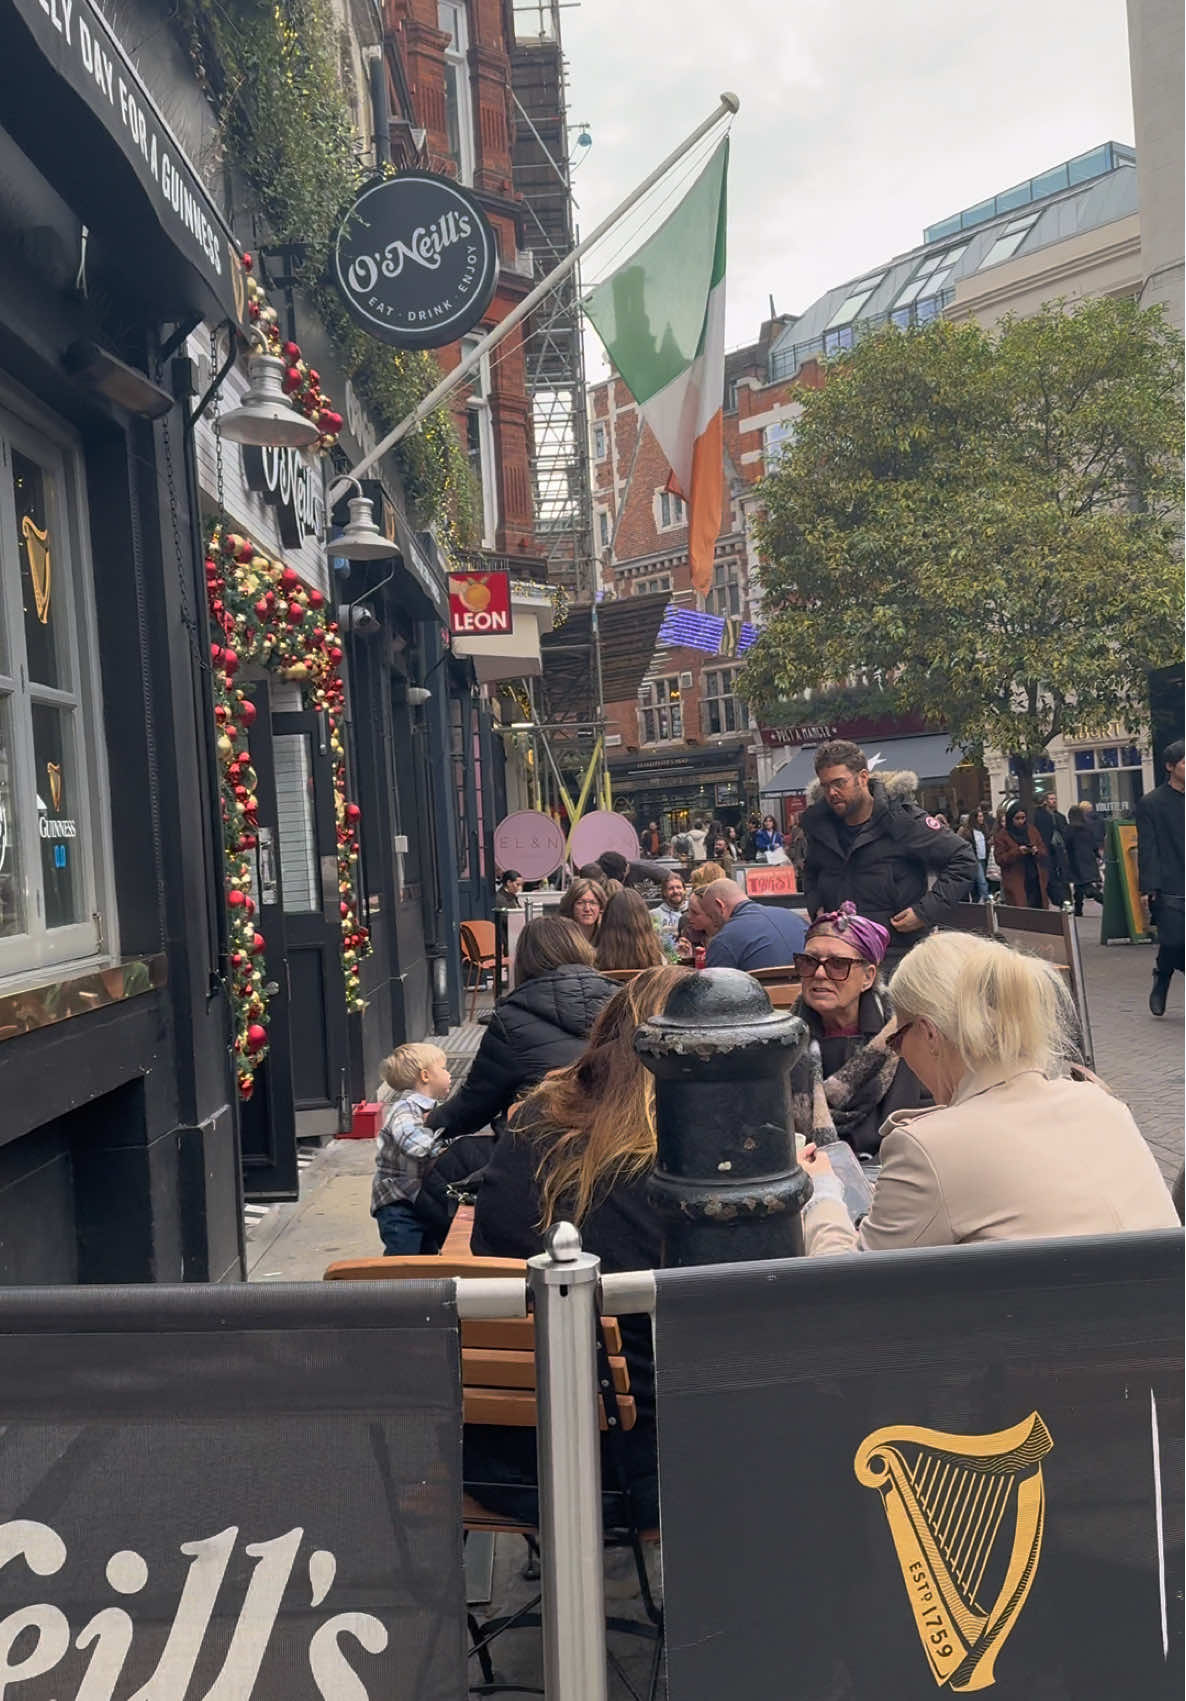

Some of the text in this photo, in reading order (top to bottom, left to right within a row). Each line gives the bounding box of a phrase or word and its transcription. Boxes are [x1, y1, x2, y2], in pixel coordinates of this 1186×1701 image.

[79, 16, 113, 105] DAY
[119, 77, 149, 162] FOR
[150, 133, 159, 182] A
[161, 153, 222, 275] GUINNESS
[348, 211, 472, 293] O'Neill's
[368, 245, 477, 321] EAT DRINK ENJOY
[454, 610, 507, 631] LEON
[40, 816, 76, 838] GUINNESS
[921, 1606, 953, 1658] 1759
